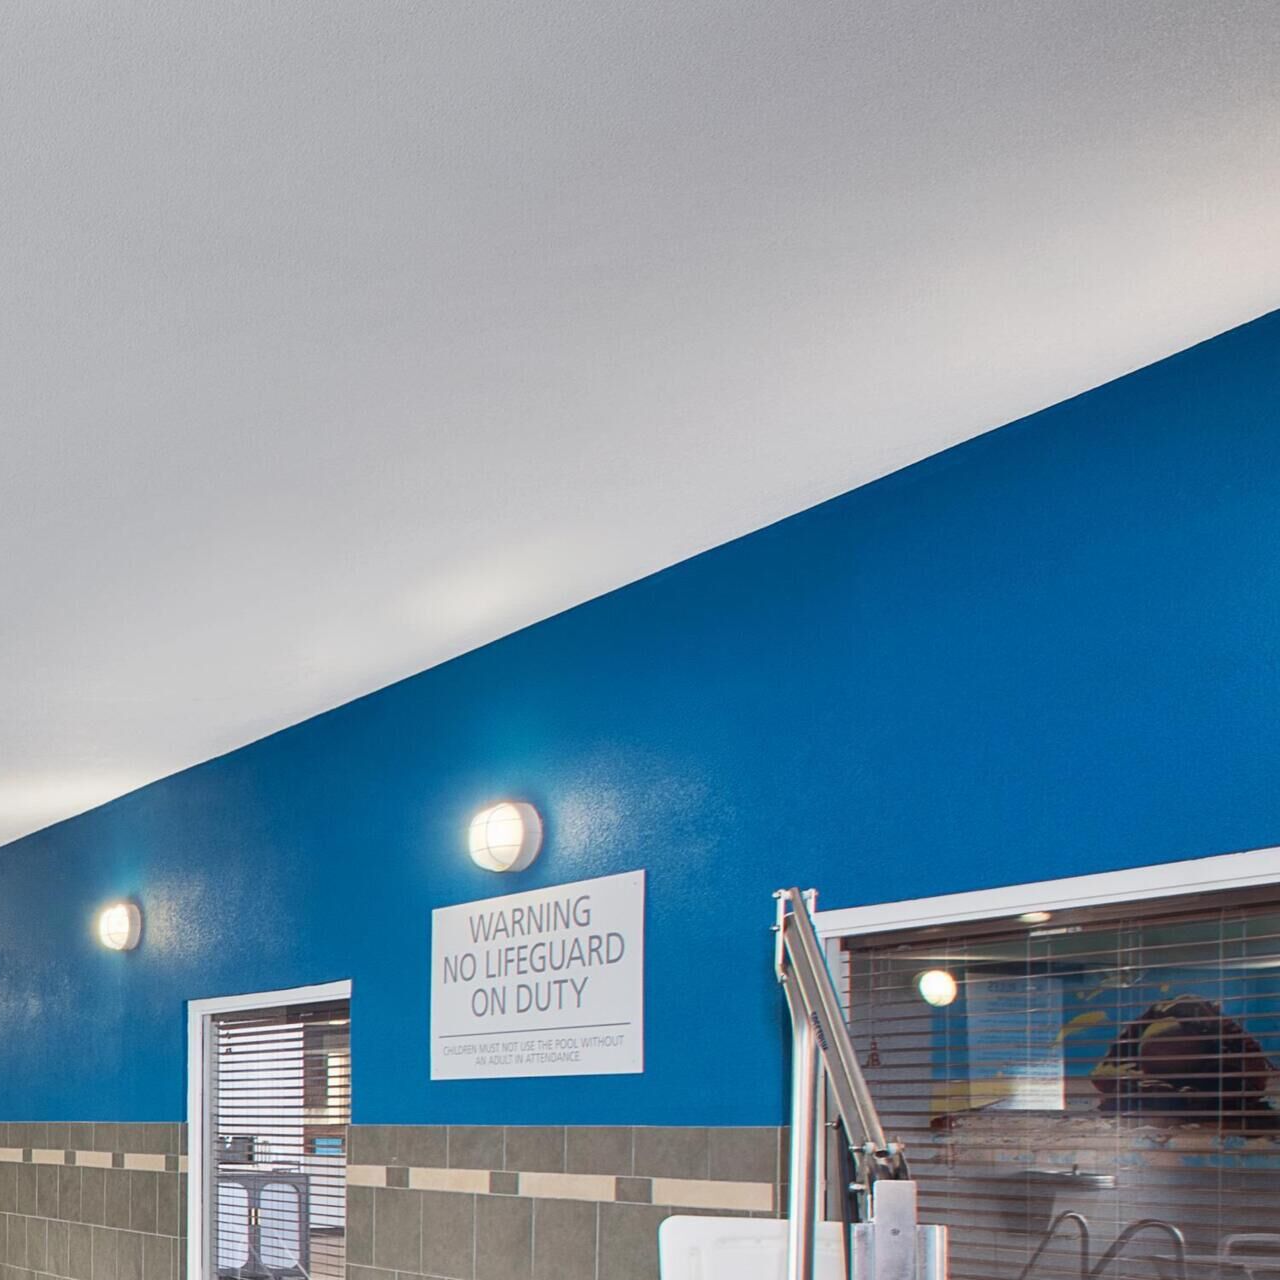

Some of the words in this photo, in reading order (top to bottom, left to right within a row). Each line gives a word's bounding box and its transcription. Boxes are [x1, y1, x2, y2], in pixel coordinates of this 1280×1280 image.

[468, 894, 591, 944] WARNING
[442, 952, 477, 985] NO
[485, 931, 626, 979] LIFEGUARD
[470, 984, 507, 1018] ON
[516, 975, 590, 1014] DUTY
[443, 1043, 477, 1056] CHILDREN
[479, 1042, 500, 1055] MUST
[502, 1041, 519, 1053] NOT
[520, 1040, 536, 1052] USE
[537, 1039, 554, 1051] THE
[555, 1037, 579, 1050] POOL
[580, 1034, 625, 1049] WITHOUT
[475, 1055, 487, 1066] AN
[488, 1053, 514, 1065] ADULT
[514, 1053, 524, 1064] IN
